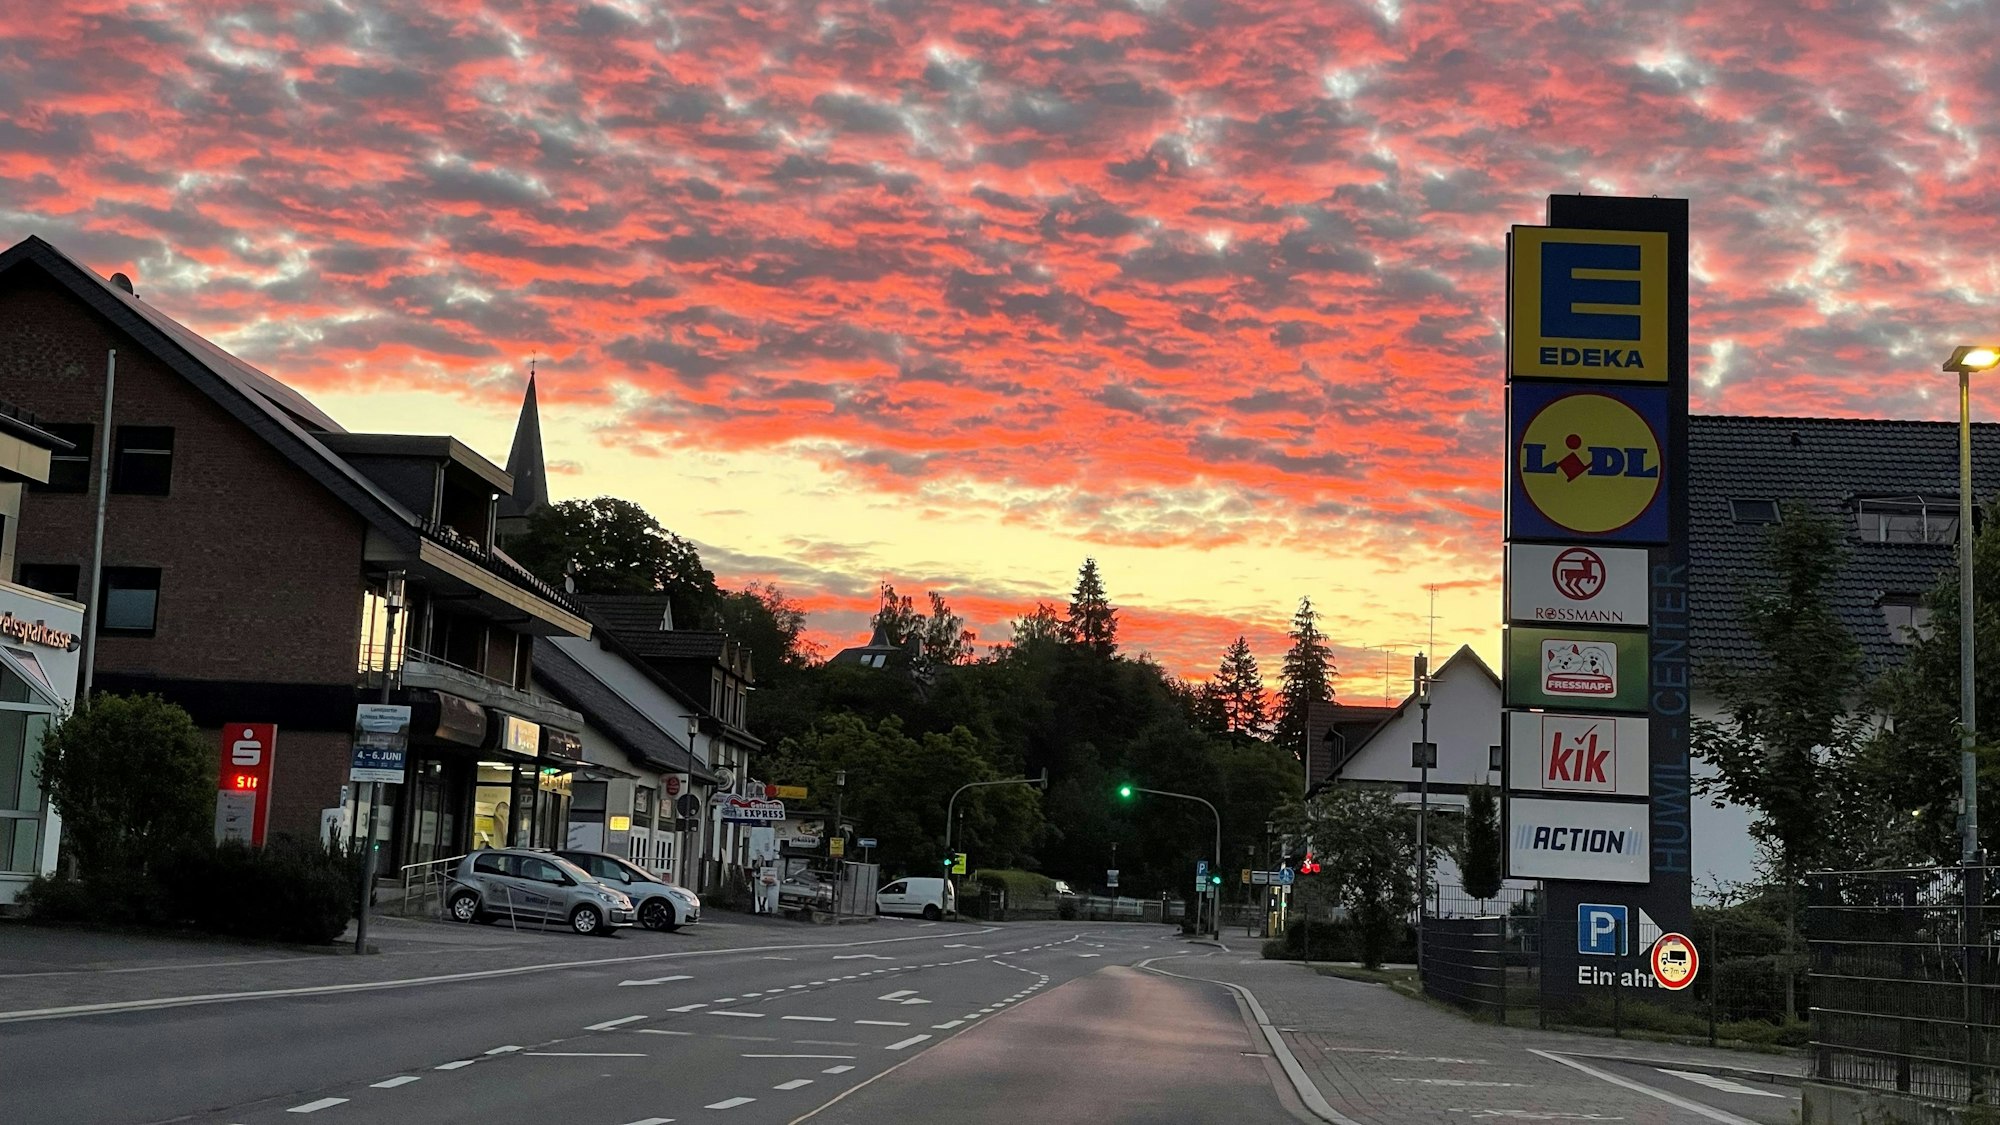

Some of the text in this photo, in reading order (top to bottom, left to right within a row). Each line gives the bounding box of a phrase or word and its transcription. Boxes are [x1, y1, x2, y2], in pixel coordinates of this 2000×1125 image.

[1539, 347, 1644, 369] EDEKA
[1535, 607, 1623, 622] ROSSMANN
[1654, 564, 1688, 716] CENTER
[1547, 678, 1612, 692] FRESSNAPF
[381, 752, 402, 761] JUNI
[744, 809, 784, 818] EXPRESS
[1654, 753, 1688, 873] HUWIL
[1533, 826, 1625, 854] ACTION
[1590, 911, 1615, 947] P
[1578, 966, 1664, 988] Einahr
